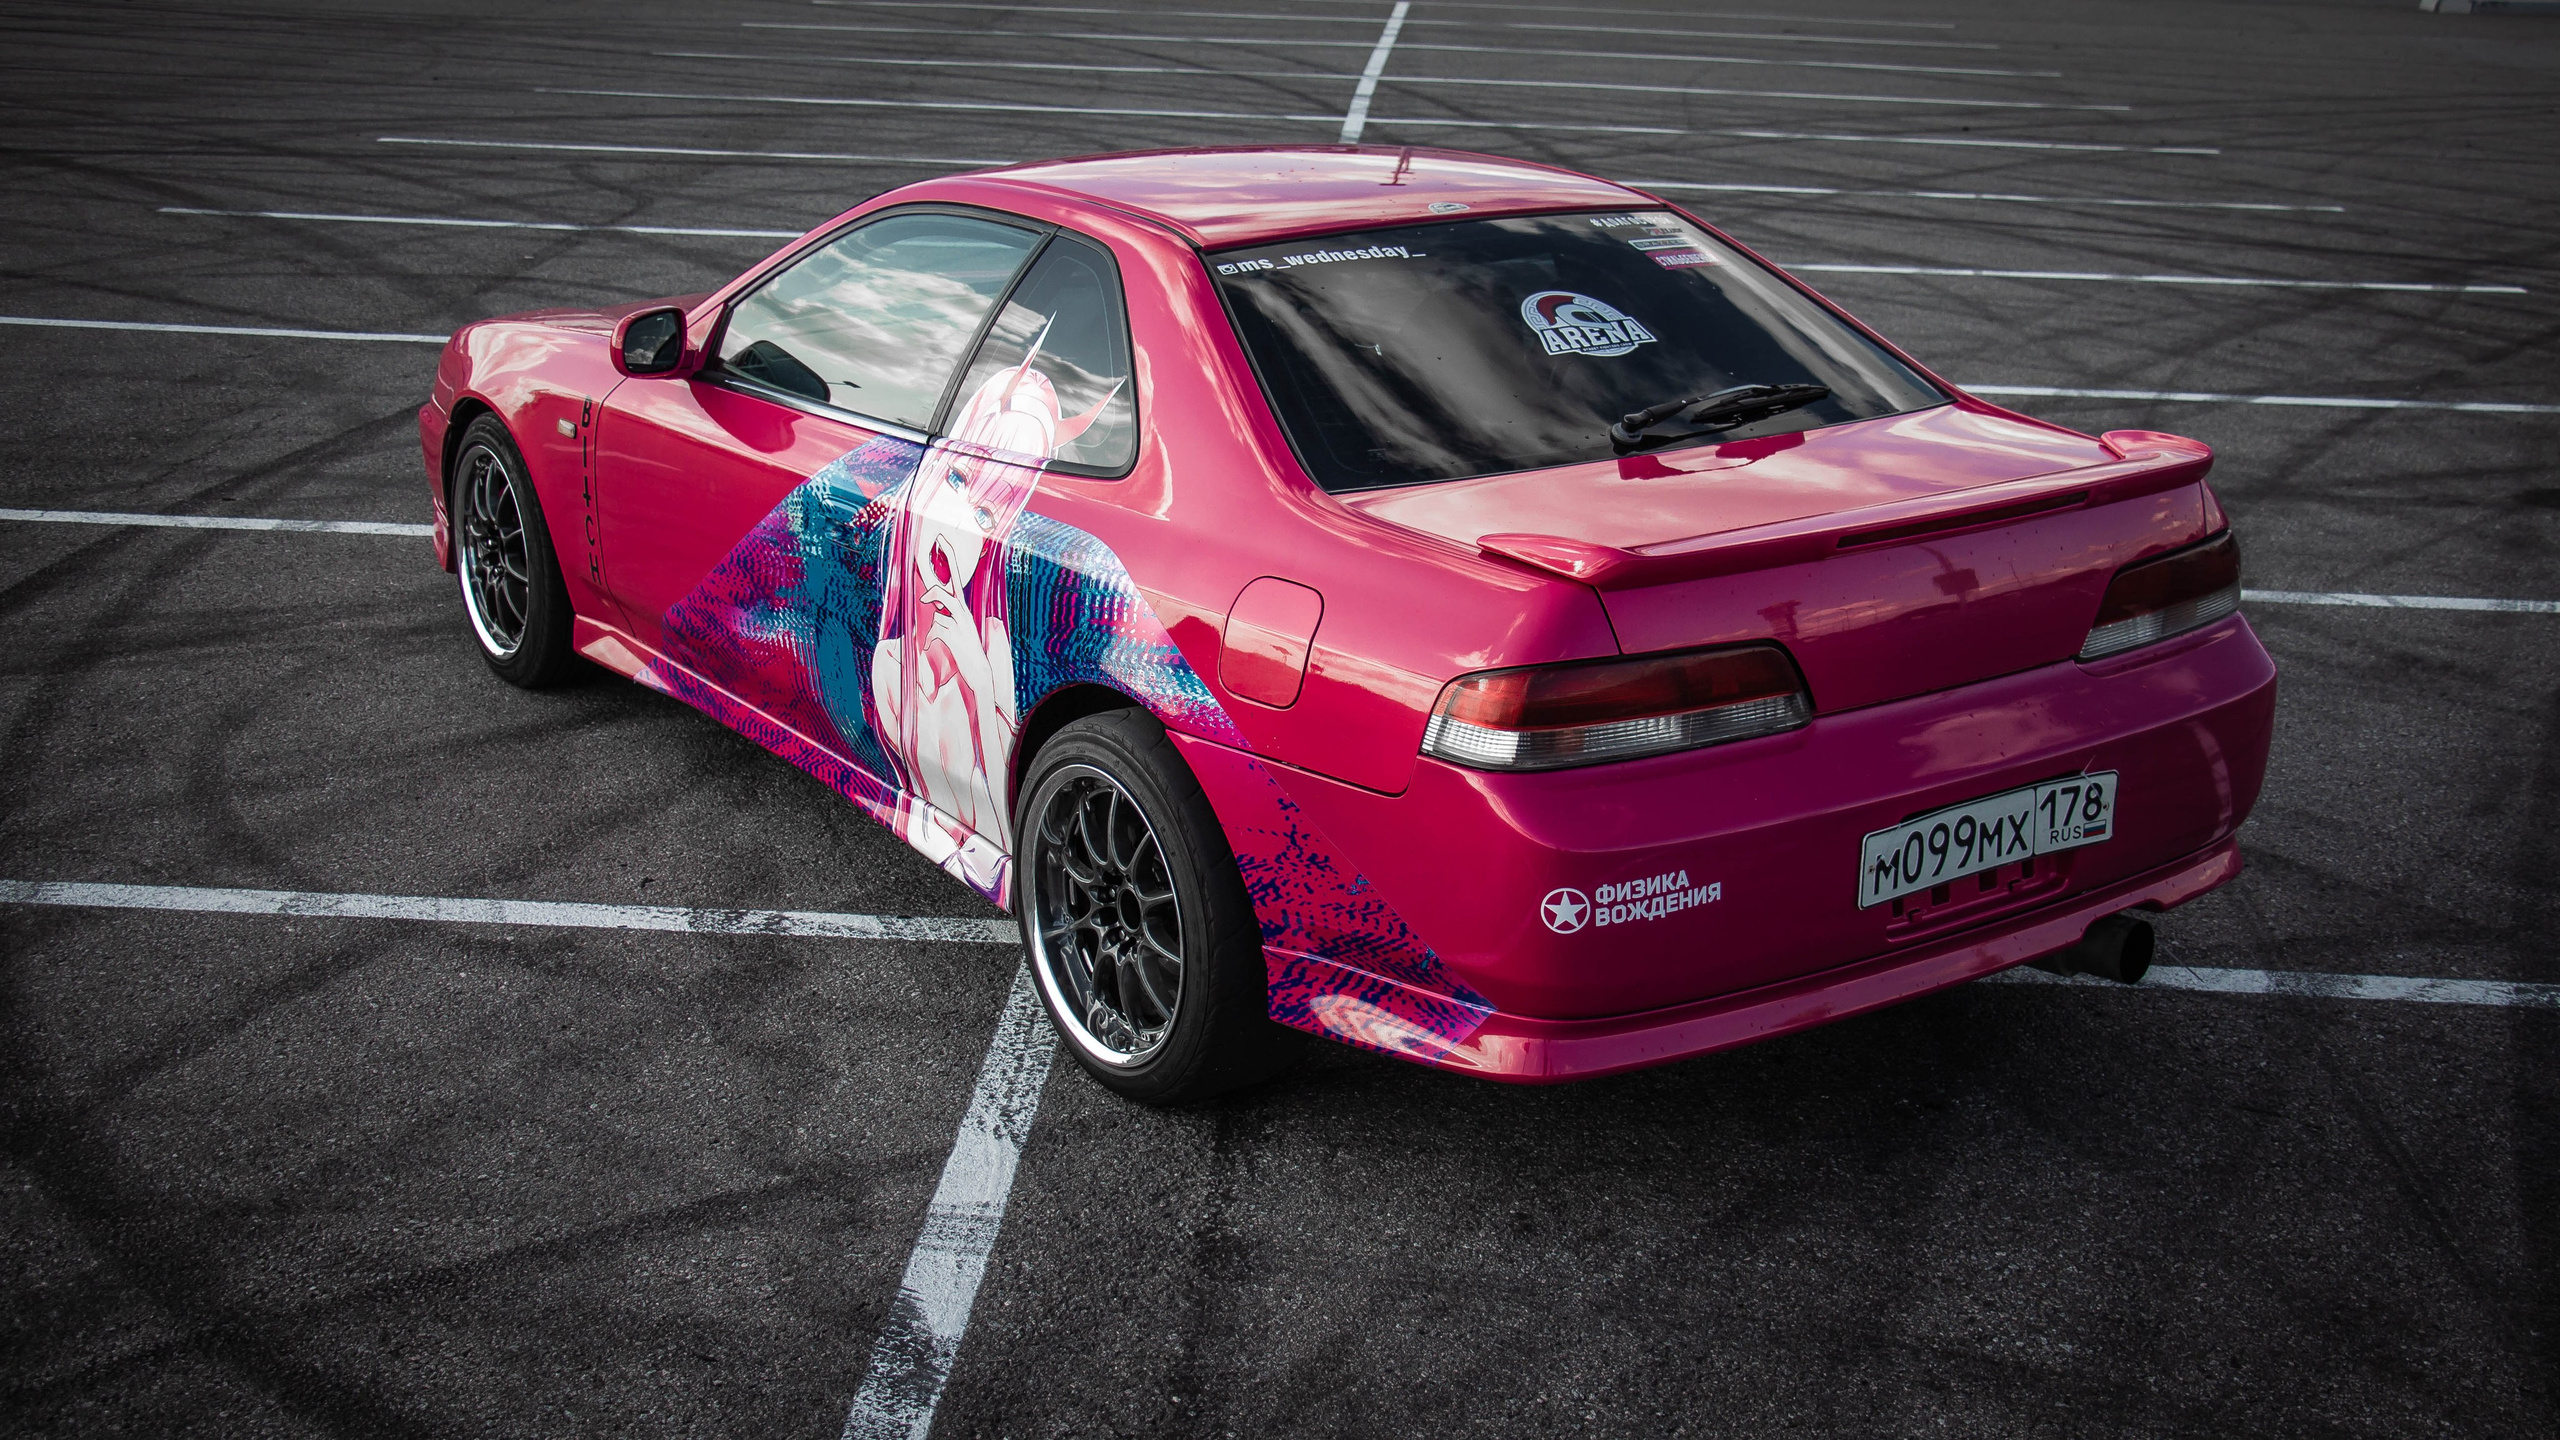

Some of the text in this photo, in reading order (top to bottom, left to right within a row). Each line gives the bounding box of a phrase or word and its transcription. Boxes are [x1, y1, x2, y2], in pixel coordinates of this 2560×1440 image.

[1236, 246, 1426, 272] ms_wednesday_
[1542, 319, 1650, 352] ARENA
[2039, 782, 2103, 829] 178
[2049, 825, 2082, 845] RUS
[1595, 869, 1690, 905] ФИЗИКА
[1595, 882, 1721, 927] ВОЖДЕНИЯ
